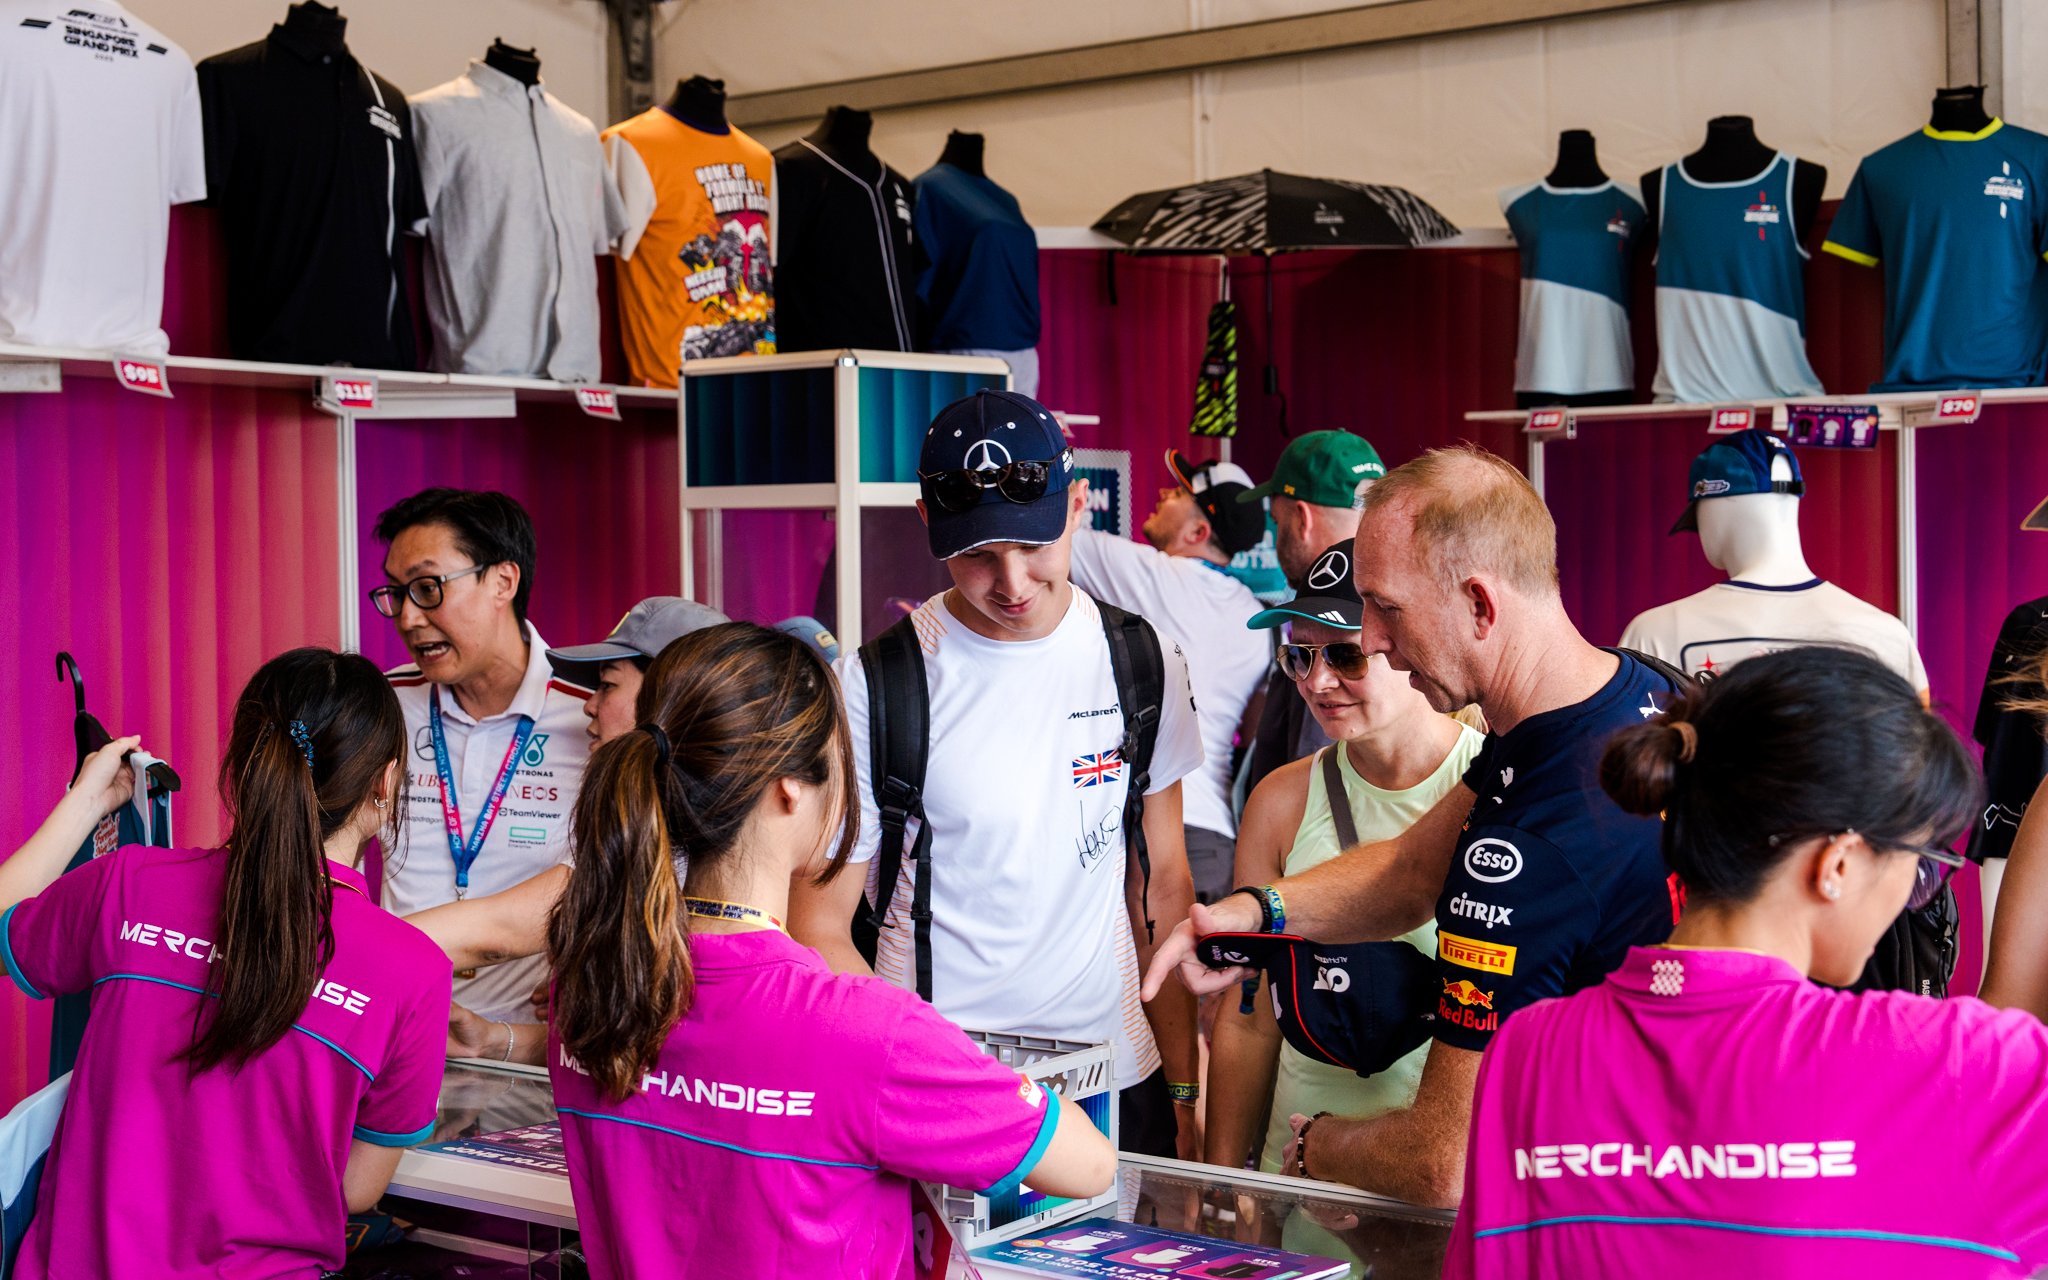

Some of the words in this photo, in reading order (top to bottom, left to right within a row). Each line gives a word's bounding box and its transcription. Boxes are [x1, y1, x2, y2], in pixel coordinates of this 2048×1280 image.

[65, 25, 136, 47] SINGAPORE
[64, 35, 110, 52] GRAND
[112, 45, 139, 58] PRIX
[1942, 399, 1975, 414] $70
[1067, 705, 1118, 720] McLaren
[417, 773, 441, 788] UB
[508, 785, 558, 801] NEOS
[508, 808, 561, 819] TeamViewer
[723, 910, 743, 920] PRIX
[724, 904, 762, 917] AIRLINES
[1443, 938, 1508, 968] PIRELLI
[1438, 997, 1462, 1026] Red
[1462, 1011, 1499, 1031] Bull
[559, 1043, 816, 1117] MHANDISE
[1010, 1248, 1054, 1260] OFF
[1059, 1255, 1103, 1269] 50%
[1102, 1265, 1136, 1275] AT
